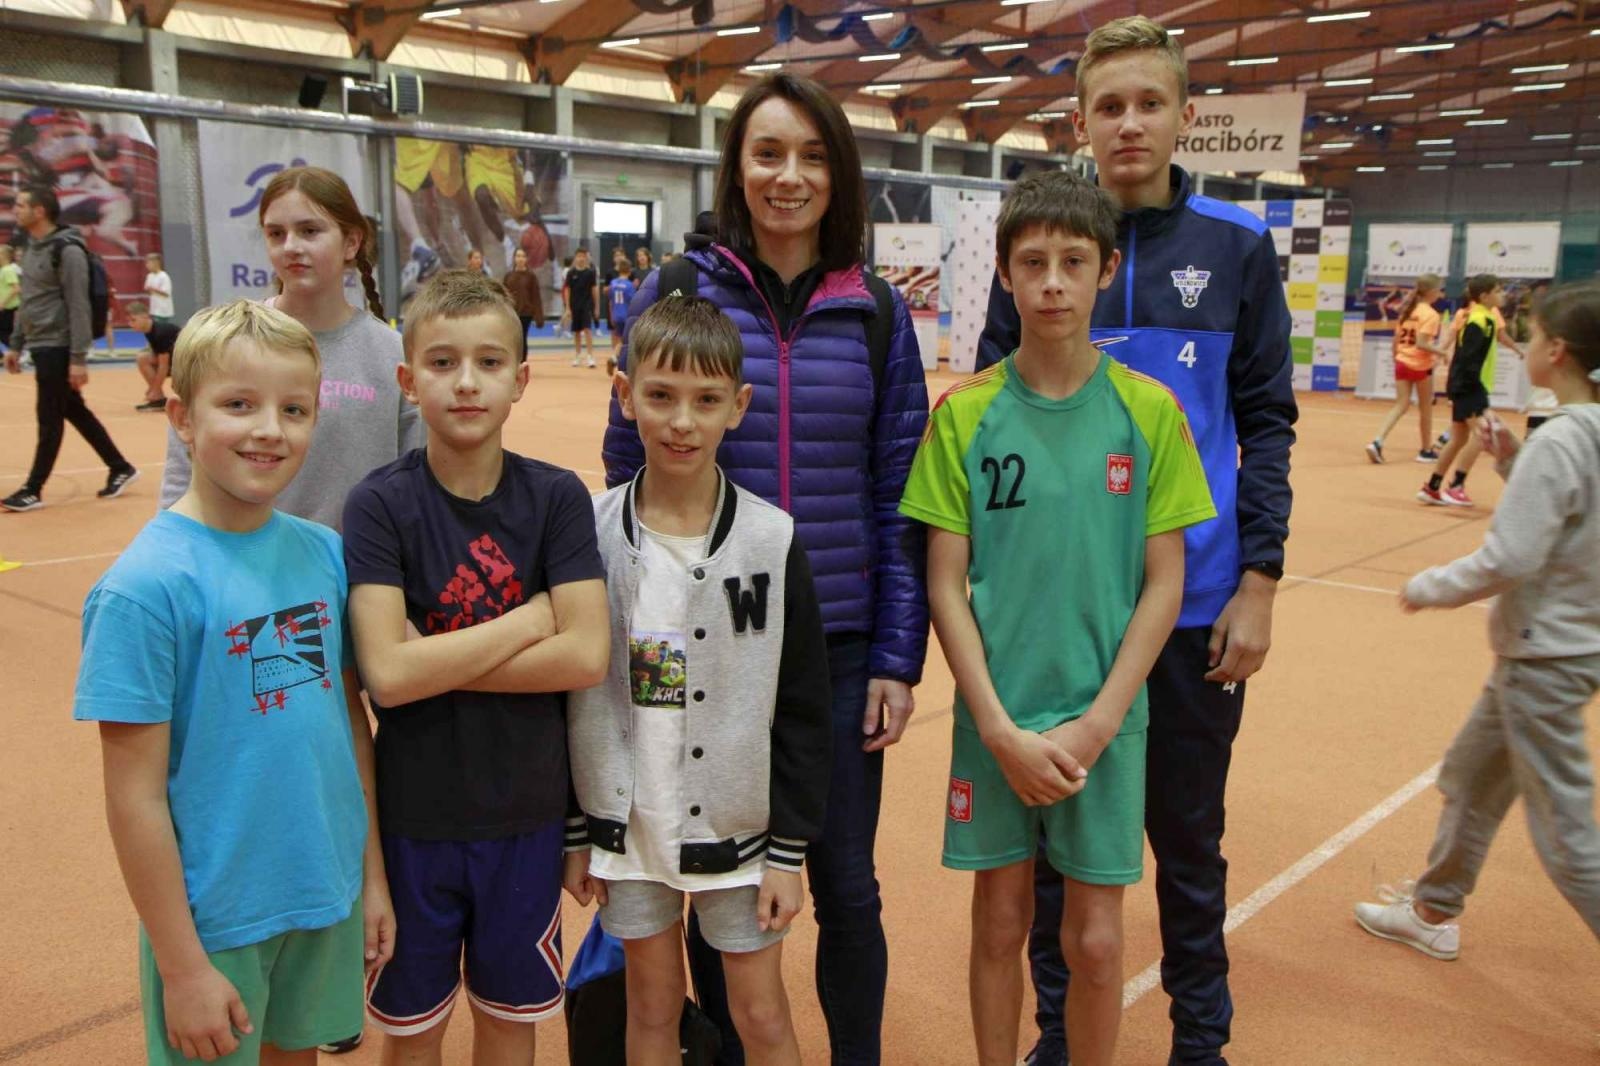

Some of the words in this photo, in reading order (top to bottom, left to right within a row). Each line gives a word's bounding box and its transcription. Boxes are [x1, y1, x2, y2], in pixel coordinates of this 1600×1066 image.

[1194, 114, 1234, 127] ASTO
[1174, 128, 1284, 153] Racibórz
[1177, 341, 1197, 368] 4
[319, 379, 376, 401] CTION
[981, 453, 1027, 511] 22
[723, 572, 770, 635] W
[652, 687, 684, 702] KAC
